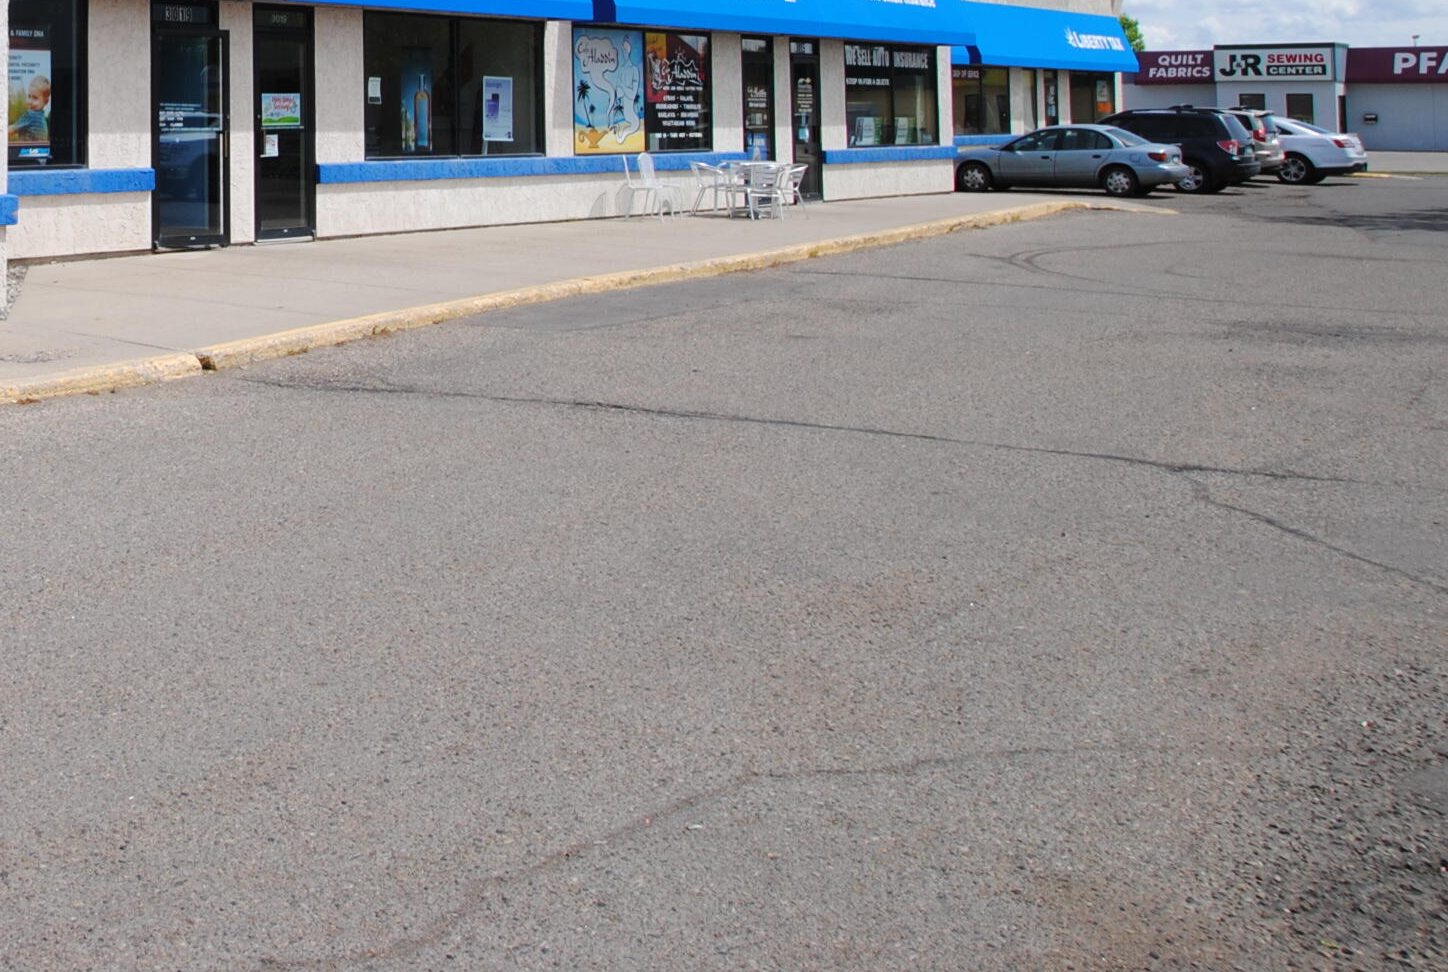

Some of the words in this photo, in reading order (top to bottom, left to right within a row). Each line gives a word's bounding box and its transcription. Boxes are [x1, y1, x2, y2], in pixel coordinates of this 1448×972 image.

[1157, 53, 1204, 67] QUILT
[1267, 53, 1325, 65] SEWING
[1148, 66, 1211, 79] FABRICS
[1268, 65, 1324, 76] CENTER
